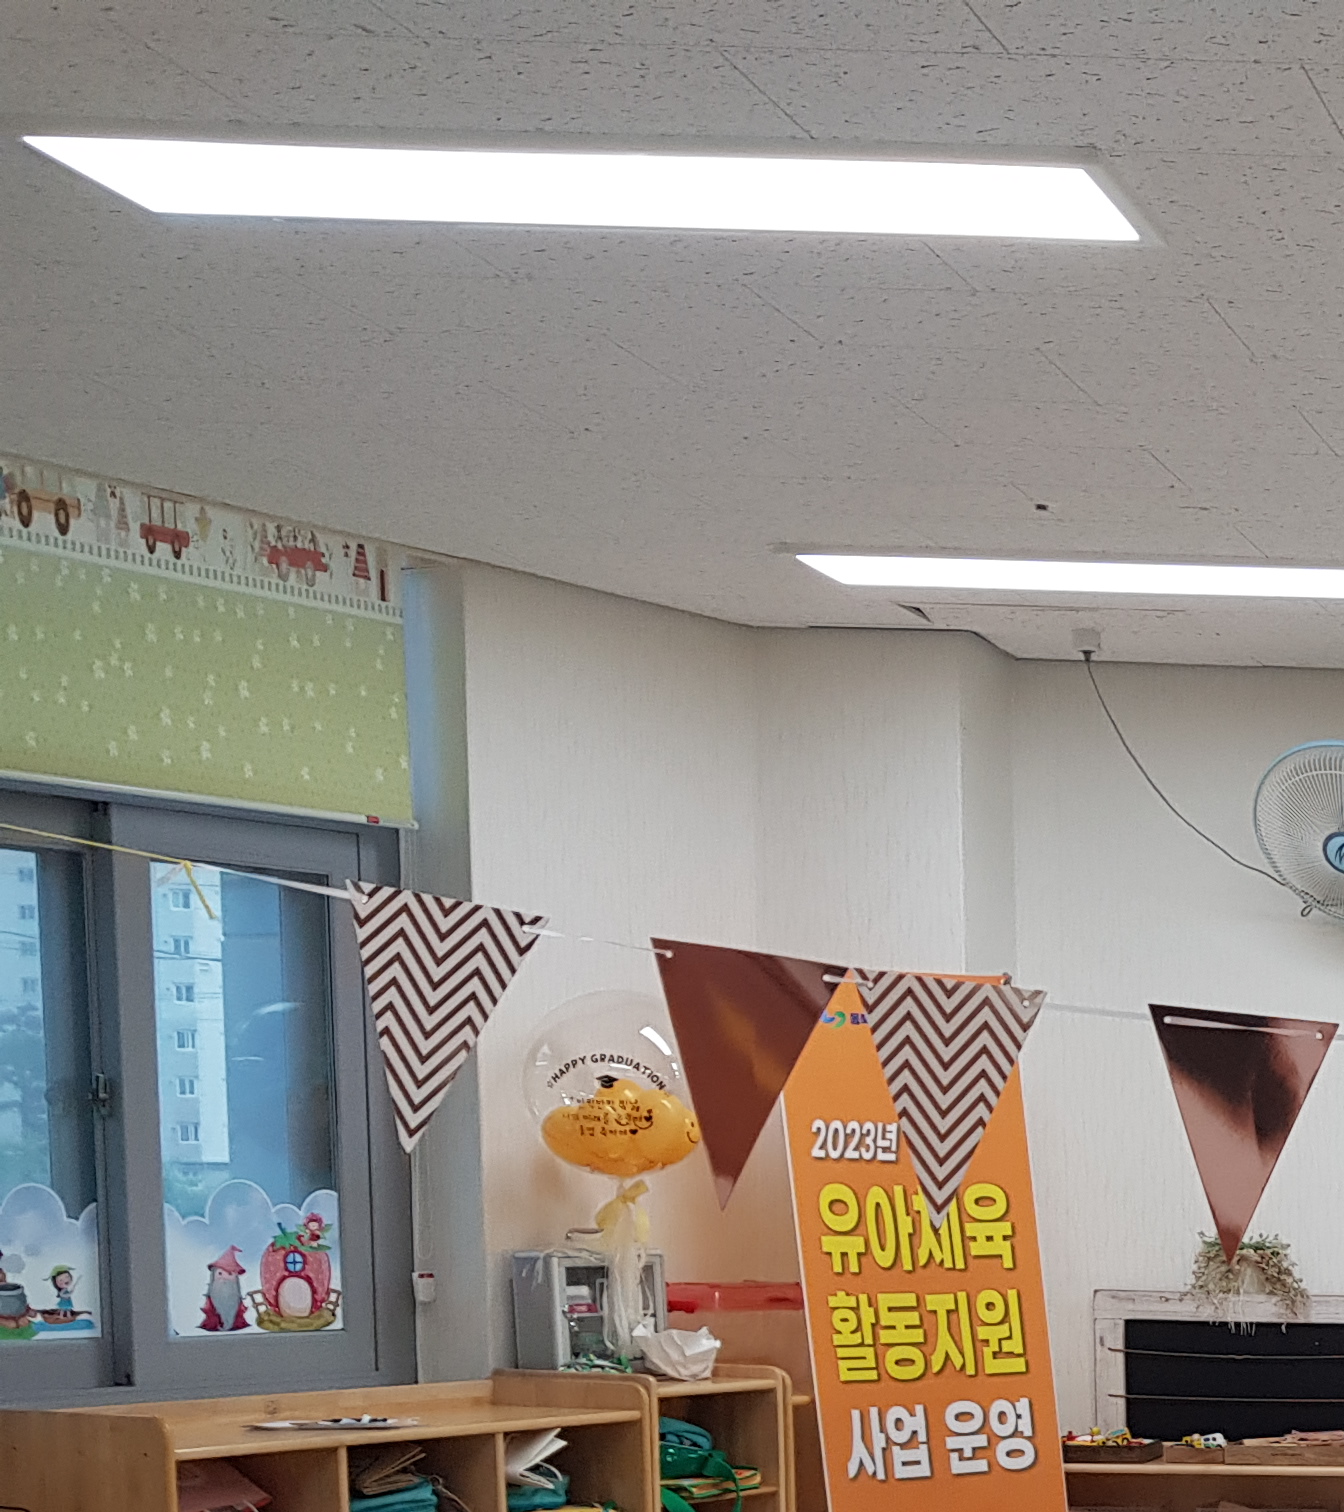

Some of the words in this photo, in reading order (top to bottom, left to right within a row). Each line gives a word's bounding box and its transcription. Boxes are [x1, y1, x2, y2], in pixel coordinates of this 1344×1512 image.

[551, 1055, 587, 1083] HAPPY
[590, 1053, 666, 1091] GRADUATION
[810, 1117, 898, 1163] 2023년
[818, 1182, 1016, 1273] 유아체육
[828, 1289, 1028, 1382] 활동지원
[846, 1402, 933, 1481] 사업
[943, 1396, 1037, 1476] 운영
